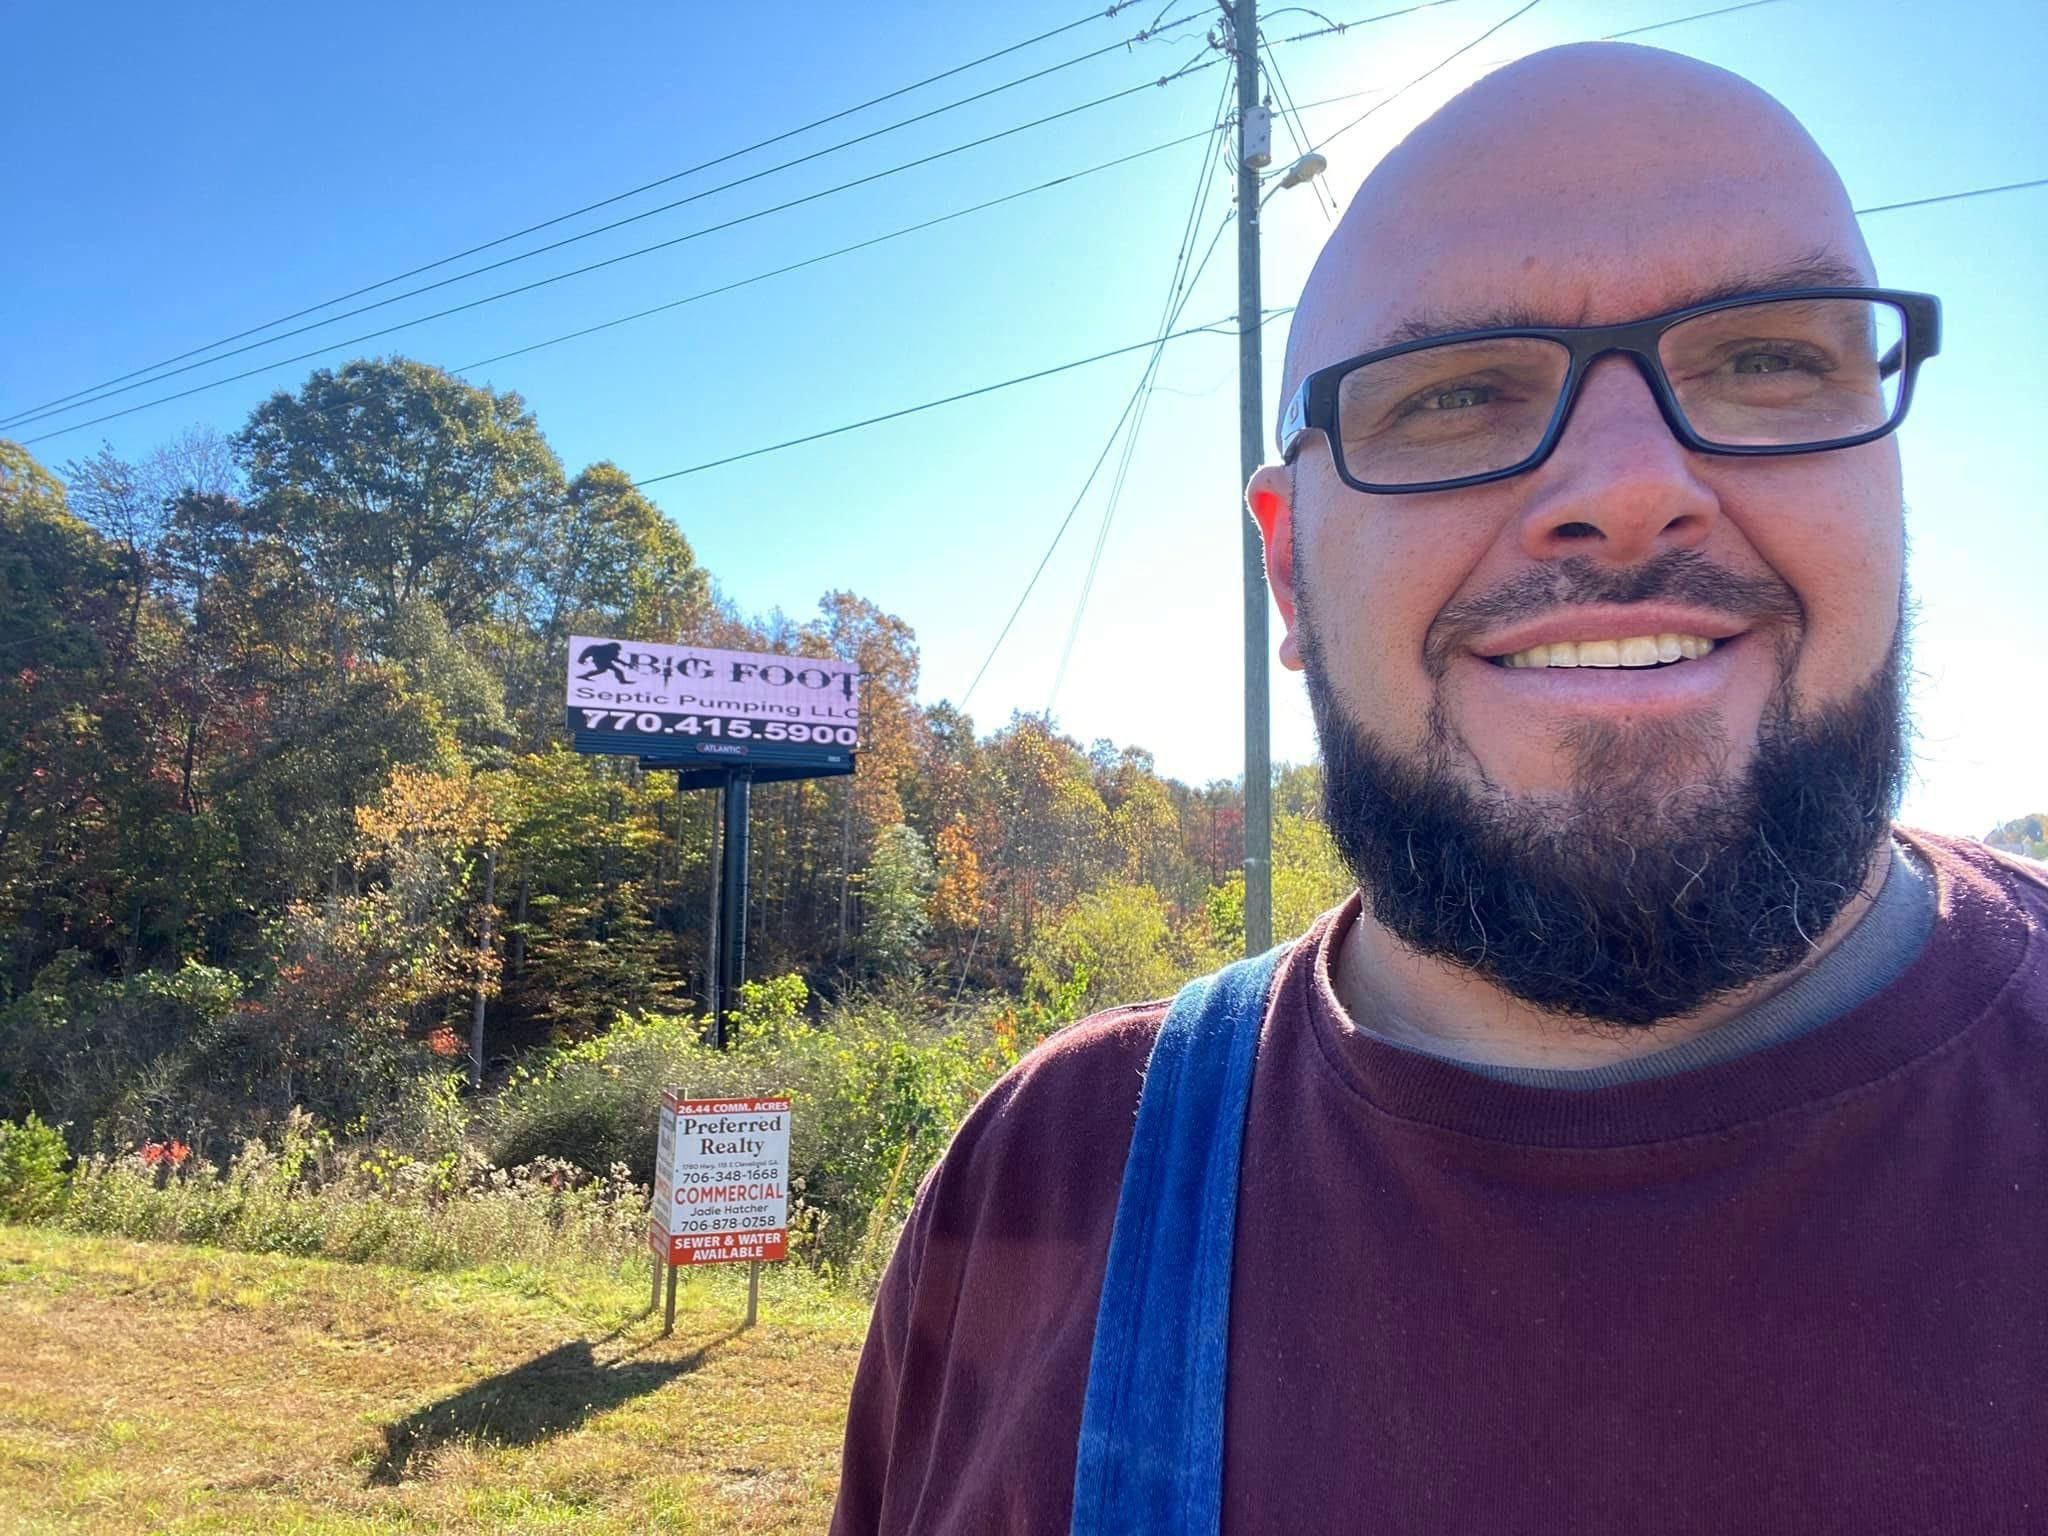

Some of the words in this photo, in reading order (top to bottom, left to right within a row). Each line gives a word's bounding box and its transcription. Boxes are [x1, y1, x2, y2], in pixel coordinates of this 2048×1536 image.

[627, 652, 714, 689] BIG
[730, 661, 859, 702] FOOT
[576, 686, 669, 704] Septic
[679, 694, 800, 718] Pumping
[581, 708, 858, 746] 770.415.5900
[703, 743, 741, 754] ATLANTIC
[678, 1104, 711, 1114] 26.44
[713, 1102, 751, 1113] COMM.
[754, 1101, 788, 1111] ACRES
[683, 1115, 782, 1136] Preferred
[700, 1137, 765, 1158] Realty
[682, 1168, 779, 1184] 706-348-1668
[674, 1183, 784, 1206] COMMERCIAL
[724, 1203, 769, 1215] Hatcher
[681, 1215, 776, 1232] 706-878-0758
[674, 1236, 720, 1249] SEWER
[724, 1234, 734, 1246] &
[738, 1232, 781, 1245] WATER
[692, 1246, 764, 1261] AVAILABLE
